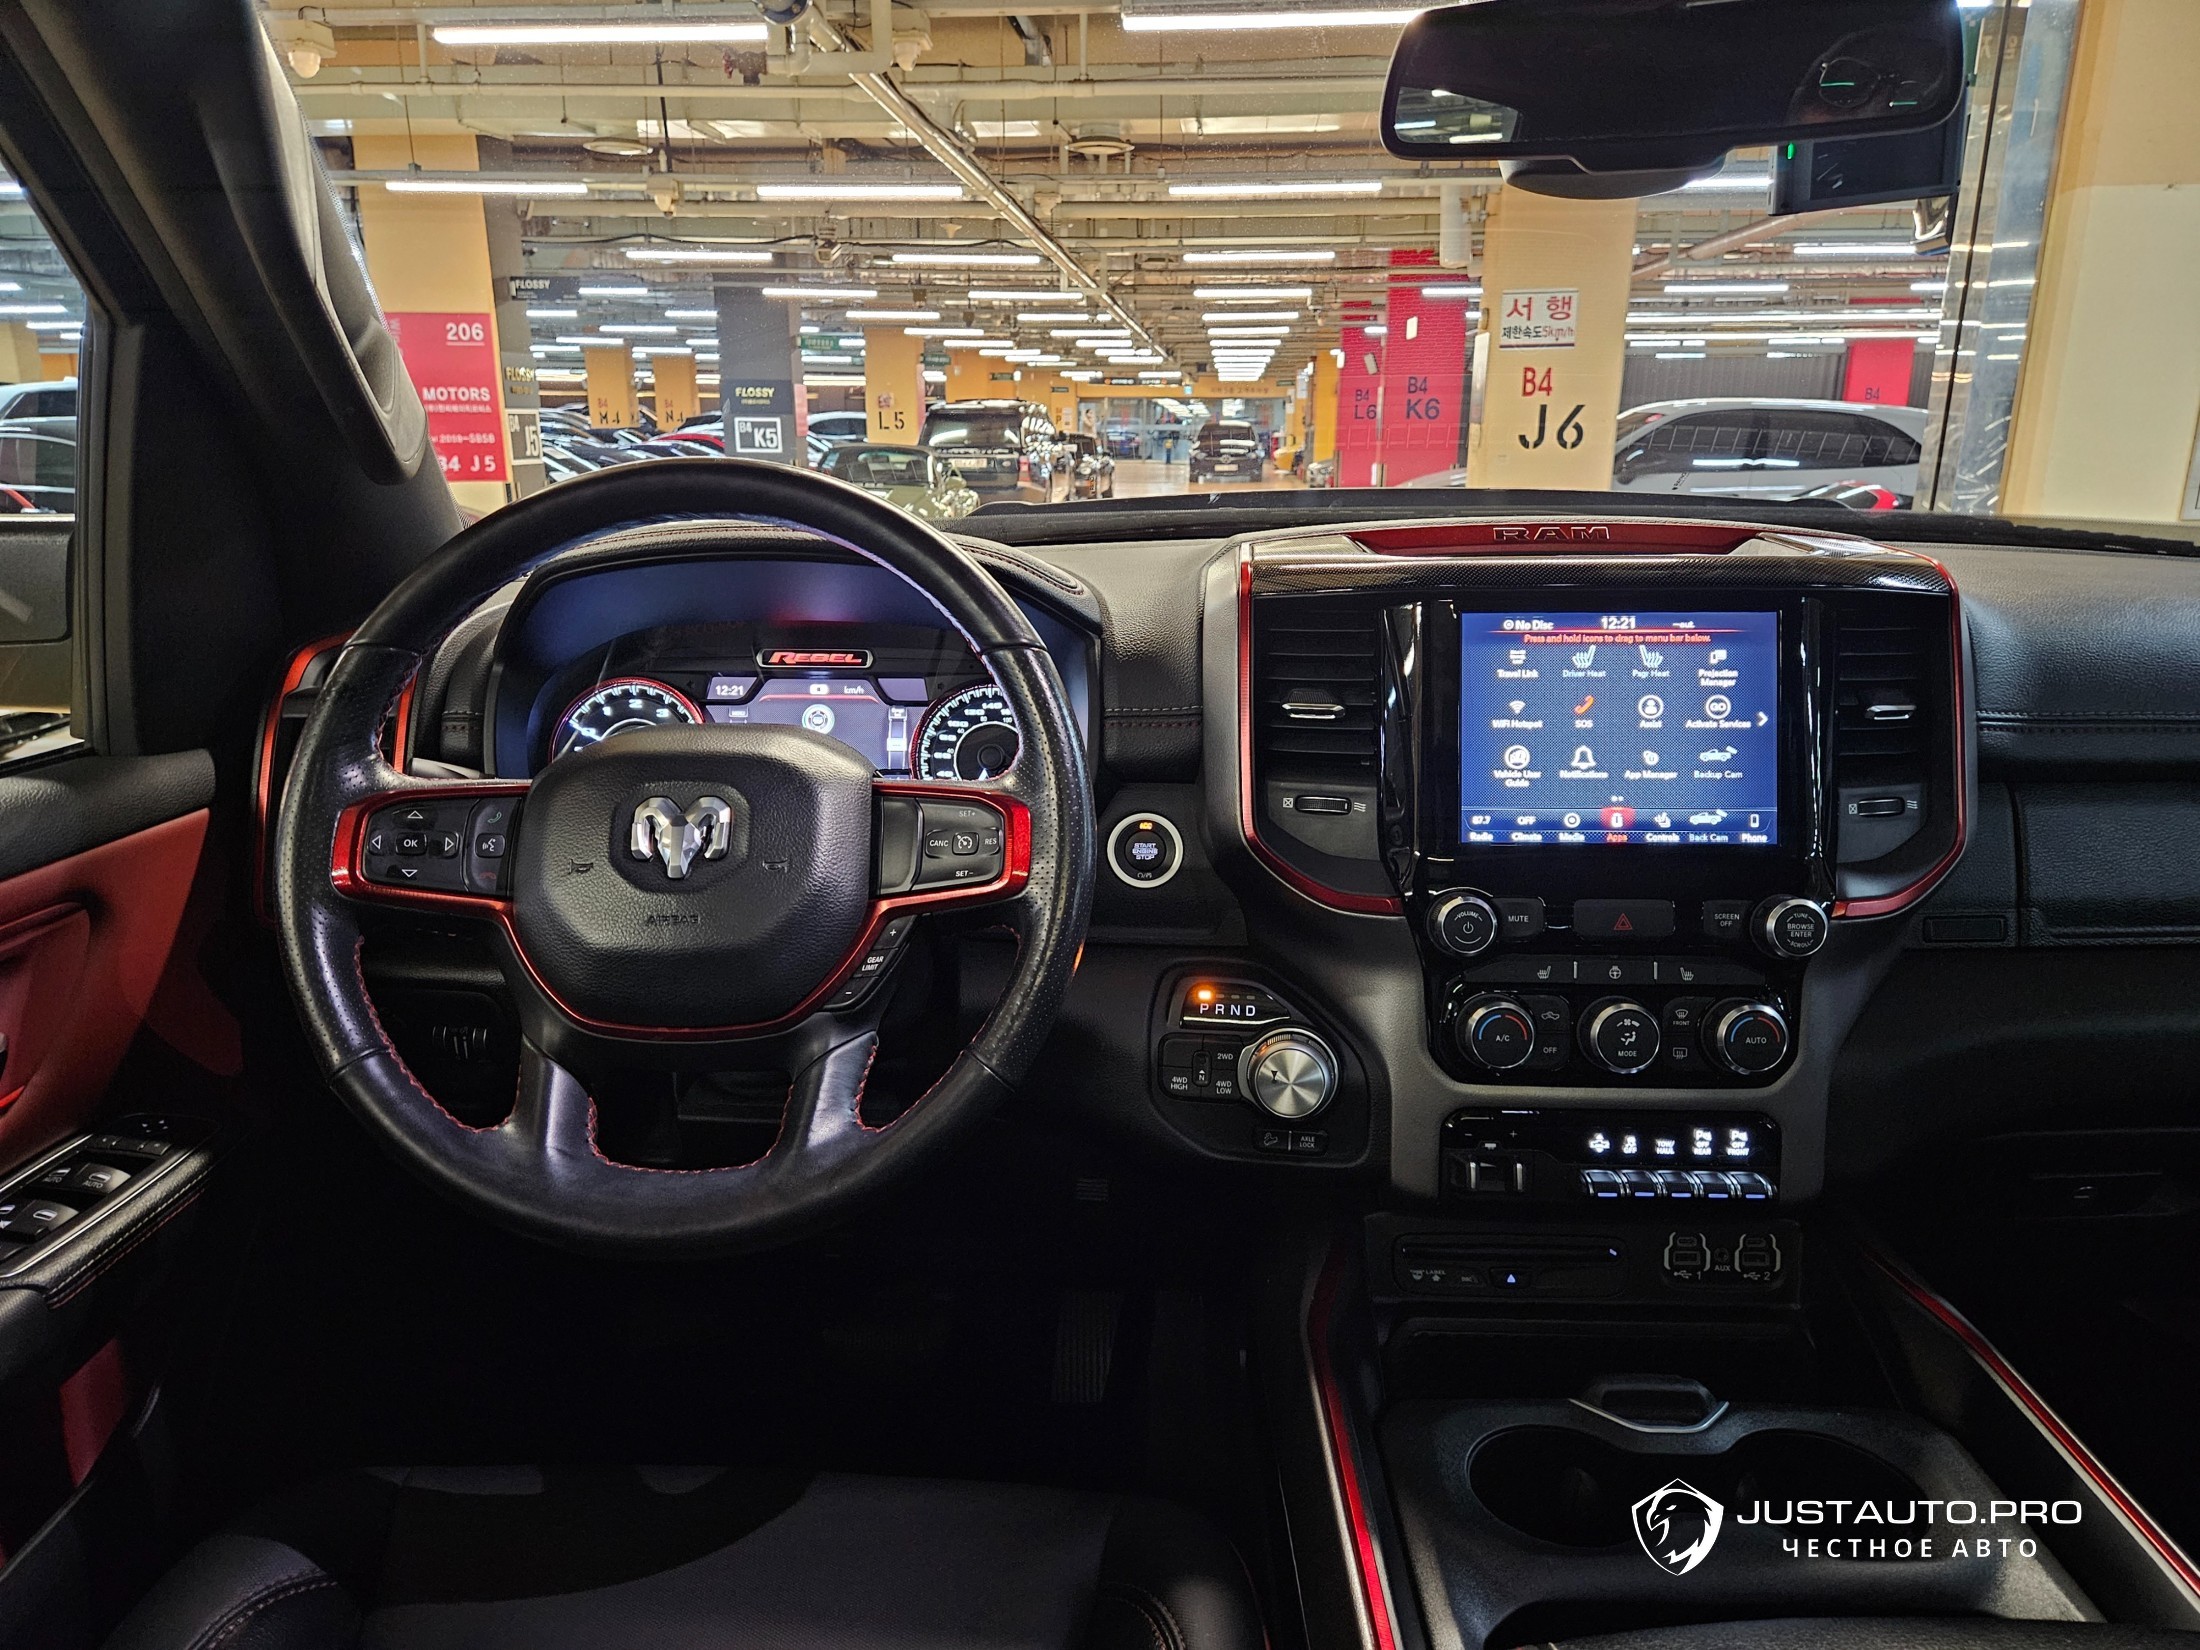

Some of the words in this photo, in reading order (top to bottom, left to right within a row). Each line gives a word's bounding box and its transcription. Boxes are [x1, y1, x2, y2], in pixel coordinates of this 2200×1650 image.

[515, 279, 550, 289] FLOSSY
[445, 323, 484, 341] 206
[1408, 376, 1428, 393] B4
[1522, 367, 1552, 397] B4
[422, 386, 491, 401] MOTORS
[735, 387, 775, 397] FLOSSY
[1355, 389, 1369, 401] B4
[1354, 405, 1377, 420] L6
[1406, 398, 1440, 419] K6
[739, 421, 752, 433] B4
[1518, 404, 1586, 449] J6
[753, 427, 778, 448] K5
[1493, 527, 1611, 541] RAM
[1515, 619, 1530, 630] No
[1532, 619, 1554, 630] Disc
[1601, 616, 1636, 629] 12:21
[1524, 634, 1545, 643] Press
[1546, 634, 1561, 643] and
[1563, 634, 1581, 643] hold
[1583, 634, 1603, 643] icons
[1605, 634, 1614, 643] to
[1615, 634, 1633, 644] drag
[1634, 634, 1644, 643] to
[1645, 634, 1668, 643] menu
[1670, 634, 1683, 643] bar
[1685, 634, 1711, 643] below.
[768, 651, 862, 664] REBEL
[1497, 669, 1521, 678] Travel
[1522, 669, 1540, 678] Link
[1562, 669, 1585, 678] Driver
[1586, 669, 1606, 678] Heat
[1651, 669, 1670, 678] Heat
[1698, 669, 1738, 680] Projection
[715, 685, 744, 695] 12:21
[844, 686, 864, 694] km/h
[629, 699, 643, 708] 2
[602, 706, 612, 716] 1
[656, 708, 670, 717] 3
[1575, 720, 1593, 729] SOS
[1639, 720, 1662, 729] Assist
[1685, 720, 1717, 729] Activate
[1719, 720, 1751, 729] Services
[1493, 770, 1522, 779] Vehicle
[1523, 770, 1542, 779] User
[1560, 770, 1608, 779] Notifications
[1625, 770, 1640, 780] App
[1641, 770, 1678, 780] Manager
[1694, 770, 1722, 780] Backup
[1723, 770, 1742, 779] Cam
[1505, 779, 1530, 787] Guide
[1517, 816, 1536, 825] OFF
[1469, 832, 1494, 841] Radio
[1511, 832, 1543, 841] Climate
[1559, 832, 1585, 841] Media
[1606, 833, 1627, 843] Apps
[1646, 832, 1680, 841] Controls
[1689, 832, 1708, 841] Back
[1710, 832, 1728, 841] Cam
[1741, 832, 1768, 841] Phone
[403, 839, 418, 848] OK
[929, 839, 949, 847] CANC
[645, 915, 699, 926] AIRBAG
[866, 956, 884, 964] GEAR
[1200, 1003, 1209, 1014] P
[1215, 1004, 1225, 1015] R
[1230, 1005, 1240, 1016] N
[1245, 1005, 1256, 1017] D
[1495, 1034, 1510, 1042] A/C
[1618, 1050, 1637, 1058] MODE
[1693, 1147, 1712, 1155] REAR
[83, 1181, 104, 1189] AUTO
[1764, 1272, 1771, 1281] 2
